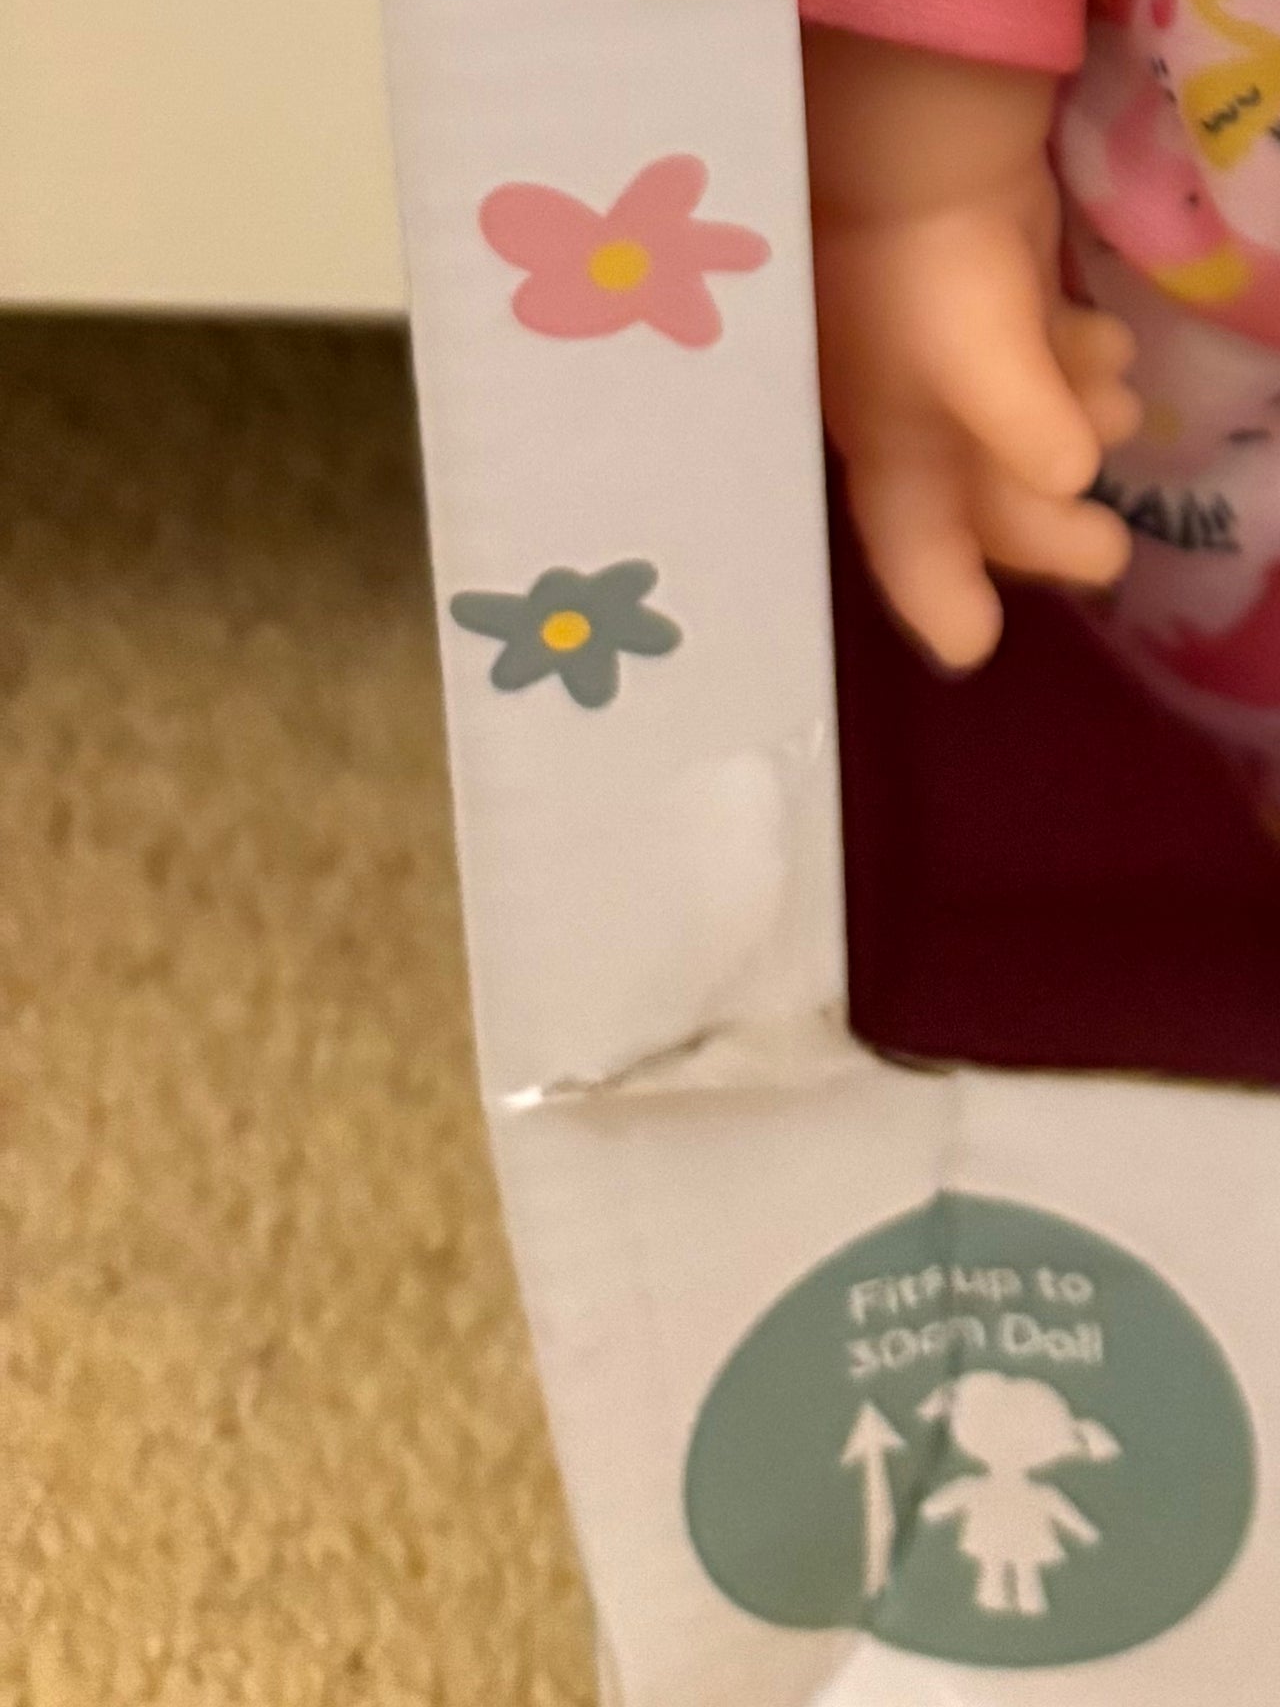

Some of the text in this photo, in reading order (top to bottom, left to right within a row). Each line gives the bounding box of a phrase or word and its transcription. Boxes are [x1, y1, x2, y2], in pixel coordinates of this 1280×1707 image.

[950, 1265, 1024, 1303] up
[1035, 1266, 1095, 1306] to
[1000, 1312, 1104, 1365] Doll
